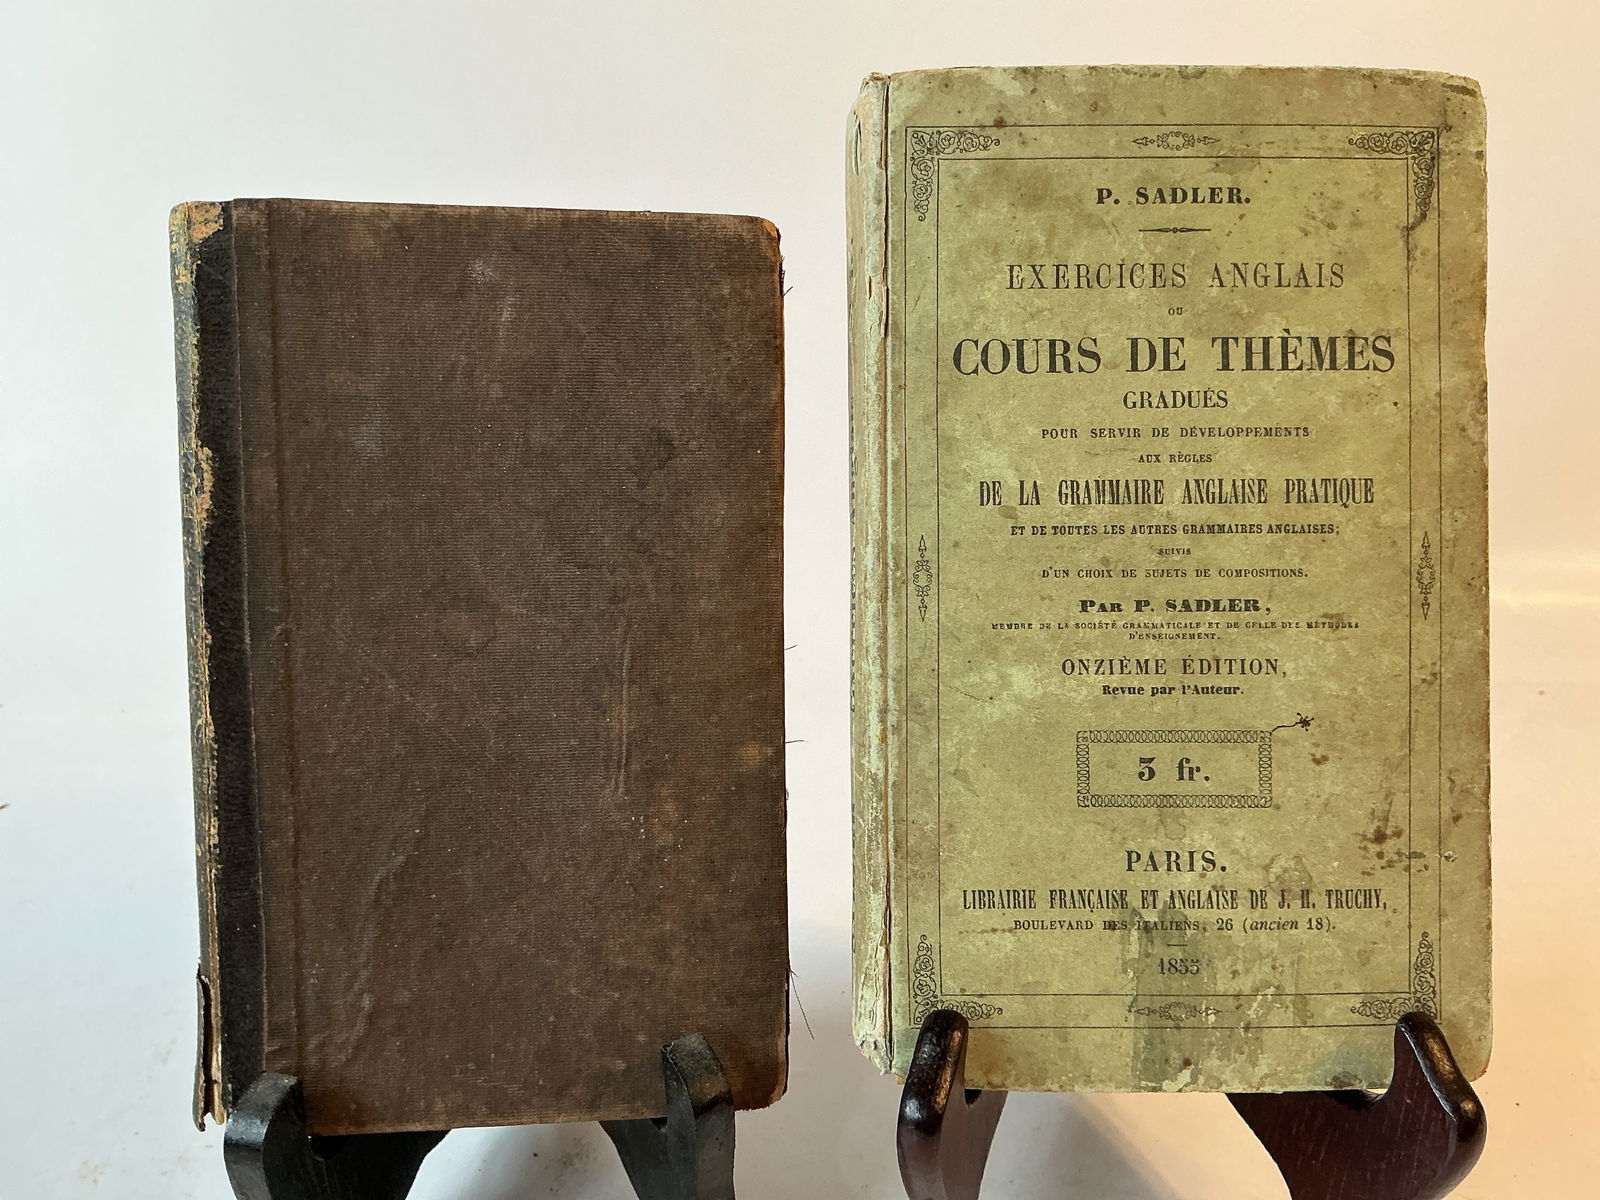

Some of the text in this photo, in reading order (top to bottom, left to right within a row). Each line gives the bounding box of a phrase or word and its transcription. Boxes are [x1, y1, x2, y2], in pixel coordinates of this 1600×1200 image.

[1095, 186, 1252, 206] P. SADLER.
[1005, 261, 1344, 290] EXERCICES ANGLAIS
[1167, 306, 1184, 317] OU
[952, 327, 1396, 377] COURS DE THÈMES
[1122, 387, 1229, 410] GRADUÉS
[1041, 425, 1310, 440] POUR SERVIR DE DÉVELOPPEMENTS
[1137, 450, 1213, 464] AUX RÈGLES
[979, 477, 1375, 509] DE LA GRAMMAIRE ANGLAISE PRATIQUE
[1010, 523, 1340, 537] ET DE TOUTES LES AUTRES GRAMMAIRES ANGLAISES;
[1041, 565, 1309, 579] D'UN CHOIX DE SUJETS DE COMPOSITIONS.
[1133, 599, 1156, 614] P.
[1165, 598, 1271, 616] SADLER,
[1056, 621, 1070, 631] LA
[1074, 620, 1117, 630] SOCIÉTÉ
[1226, 621, 1240, 629] DE
[1061, 654, 1287, 679] ONZIÈME ÉDITION,
[1101, 683, 1244, 698] Revue par l'Auteur.
[1137, 756, 1211, 782] 3 fr.
[1124, 848, 1227, 874] PARIS.
[962, 887, 1387, 914] LIBRAIRIE FRANÇAISE ET ANGLAISE DE J. H. TRUCHY,
[1011, 919, 1094, 932] BOULEVARD
[1102, 919, 1128, 933] DES
[1215, 917, 1234, 932] 26
[1242, 916, 1300, 935] (ancien
[1306, 916, 1336, 933] 18).
